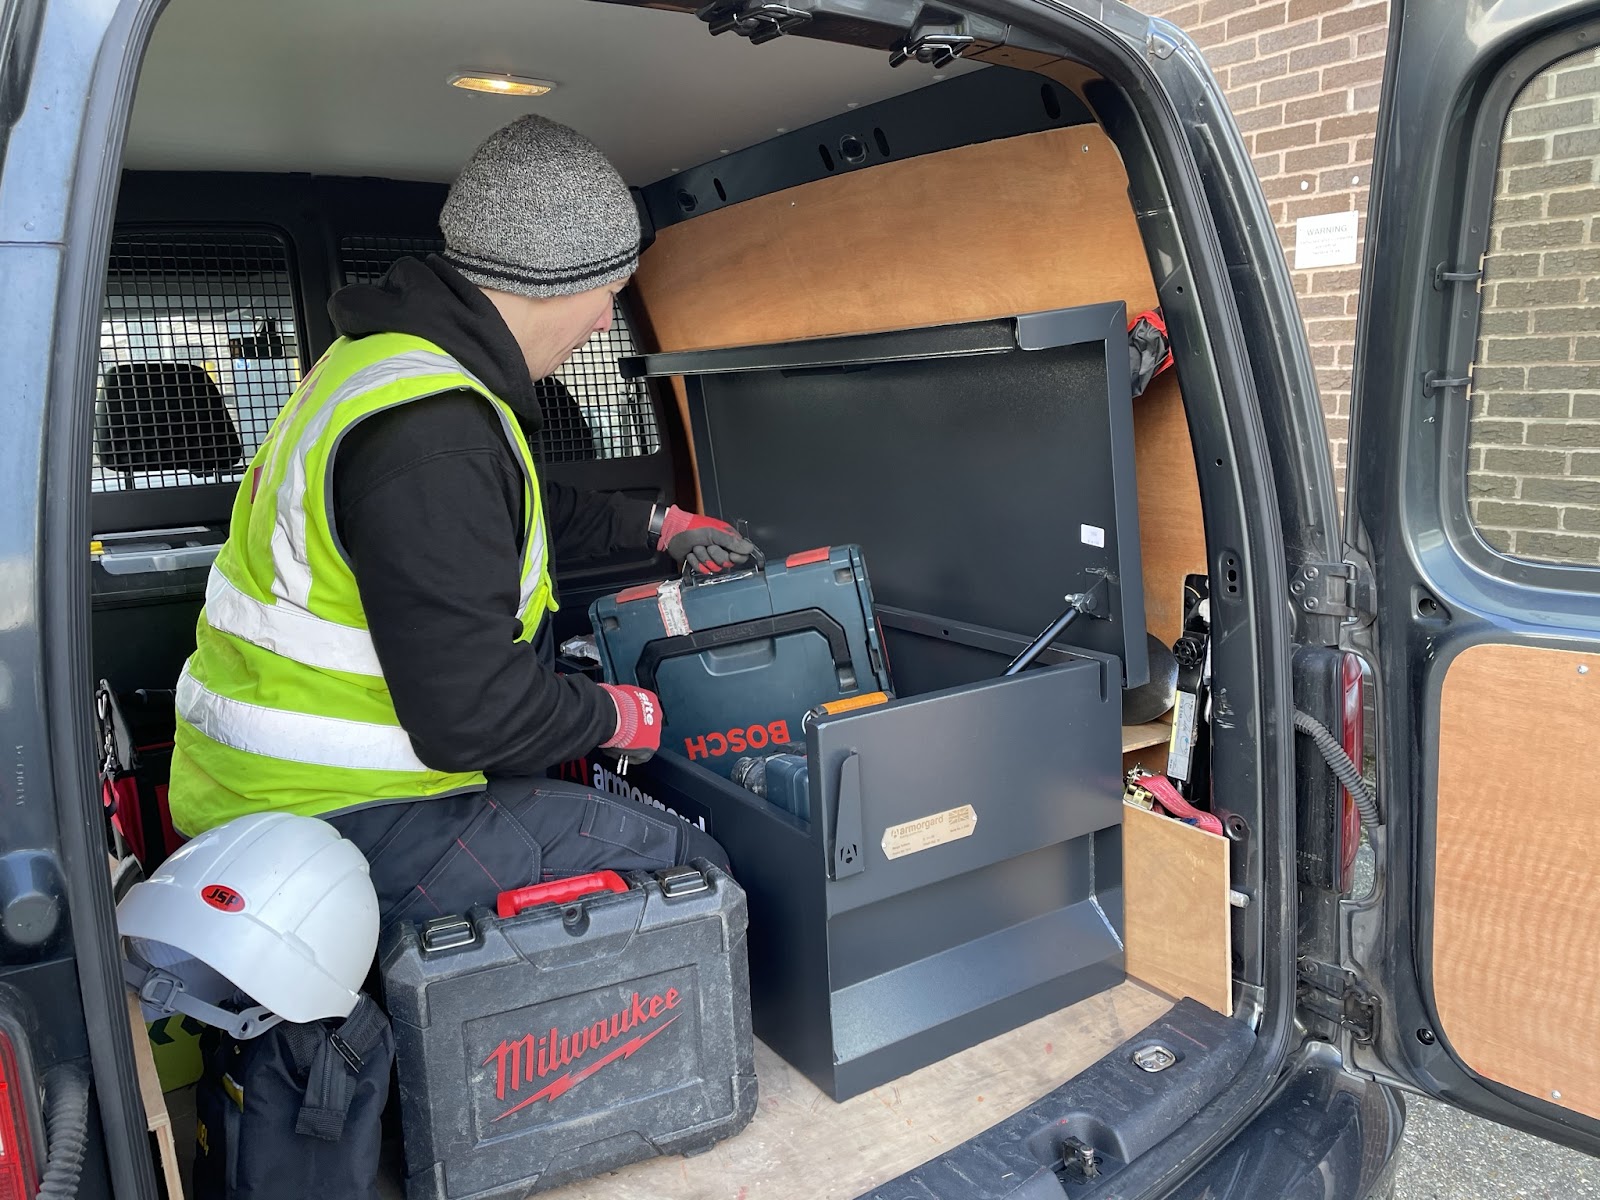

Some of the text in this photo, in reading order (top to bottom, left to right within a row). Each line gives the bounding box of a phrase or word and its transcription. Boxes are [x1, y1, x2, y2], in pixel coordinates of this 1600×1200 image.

[1306, 224, 1348, 236] WARNING
[638, 691, 655, 726] site
[684, 719, 791, 761] BOSCH
[899, 814, 944, 836] armorgard
[207, 888, 240, 906] JSP
[482, 986, 683, 1101] Milwaukee
